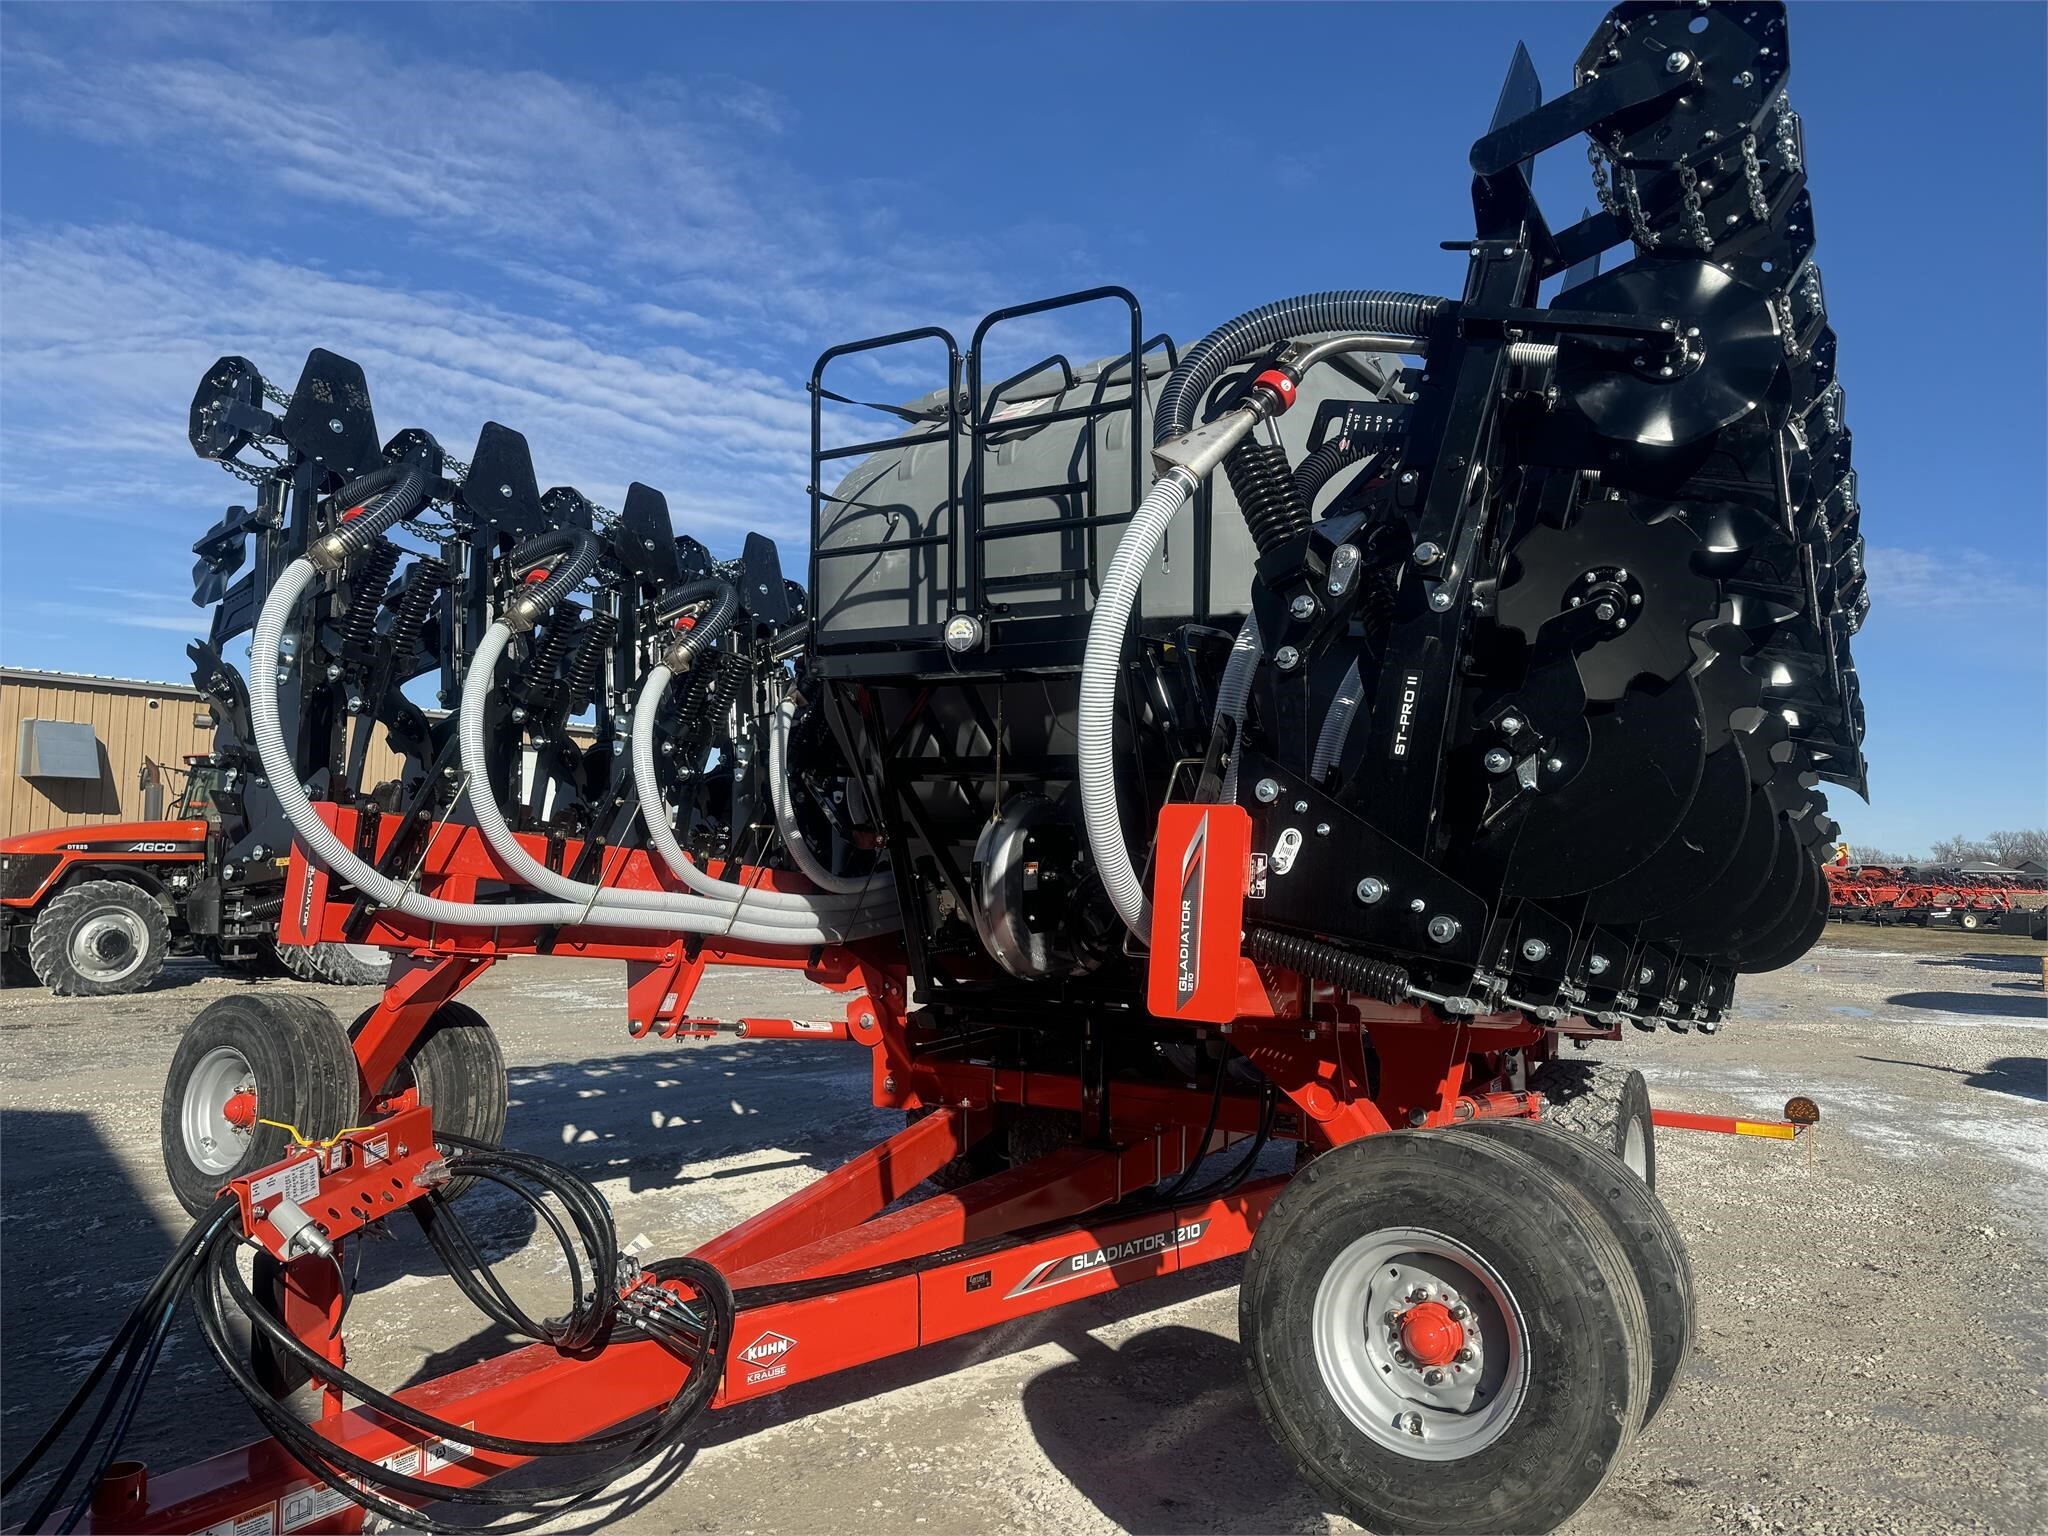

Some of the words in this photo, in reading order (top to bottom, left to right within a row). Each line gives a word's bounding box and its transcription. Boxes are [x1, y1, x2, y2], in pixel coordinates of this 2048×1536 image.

[1354, 414, 1361, 422] 12
[1376, 415, 1383, 423] 10
[1394, 690, 1415, 756] ST-PRO
[1406, 676, 1418, 685] II
[128, 842, 177, 852] AGCO
[1178, 900, 1192, 992] GLADIATOR
[1071, 1233, 1166, 1271] GLADIATOR
[1171, 1223, 1201, 1243] 1210
[747, 1339, 788, 1361] KUHN
[746, 1365, 787, 1383] KRAUSE
